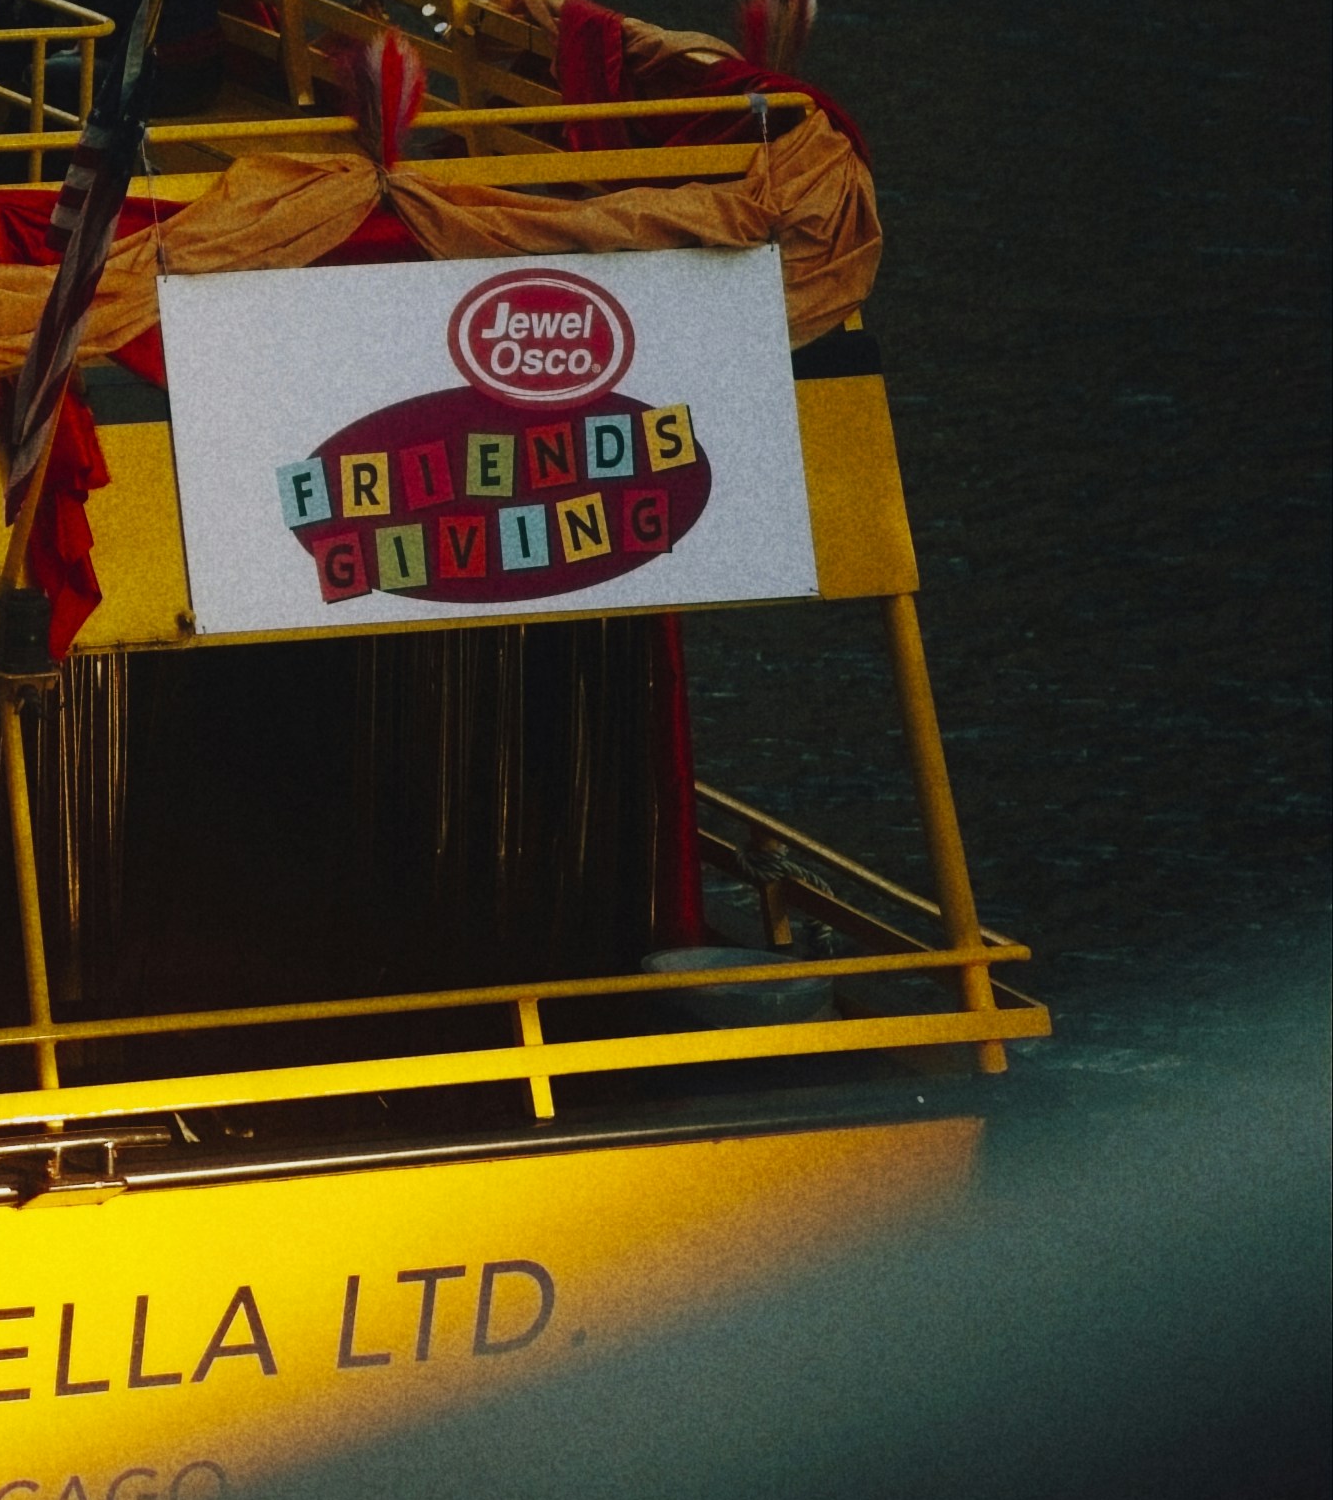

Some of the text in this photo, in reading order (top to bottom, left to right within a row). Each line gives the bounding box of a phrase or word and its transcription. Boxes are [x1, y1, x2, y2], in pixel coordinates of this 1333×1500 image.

[481, 301, 594, 340] Jewel
[291, 413, 684, 518] FRIENDS
[323, 496, 663, 589] GIVING
[336, 1257, 587, 1370] LTD.
